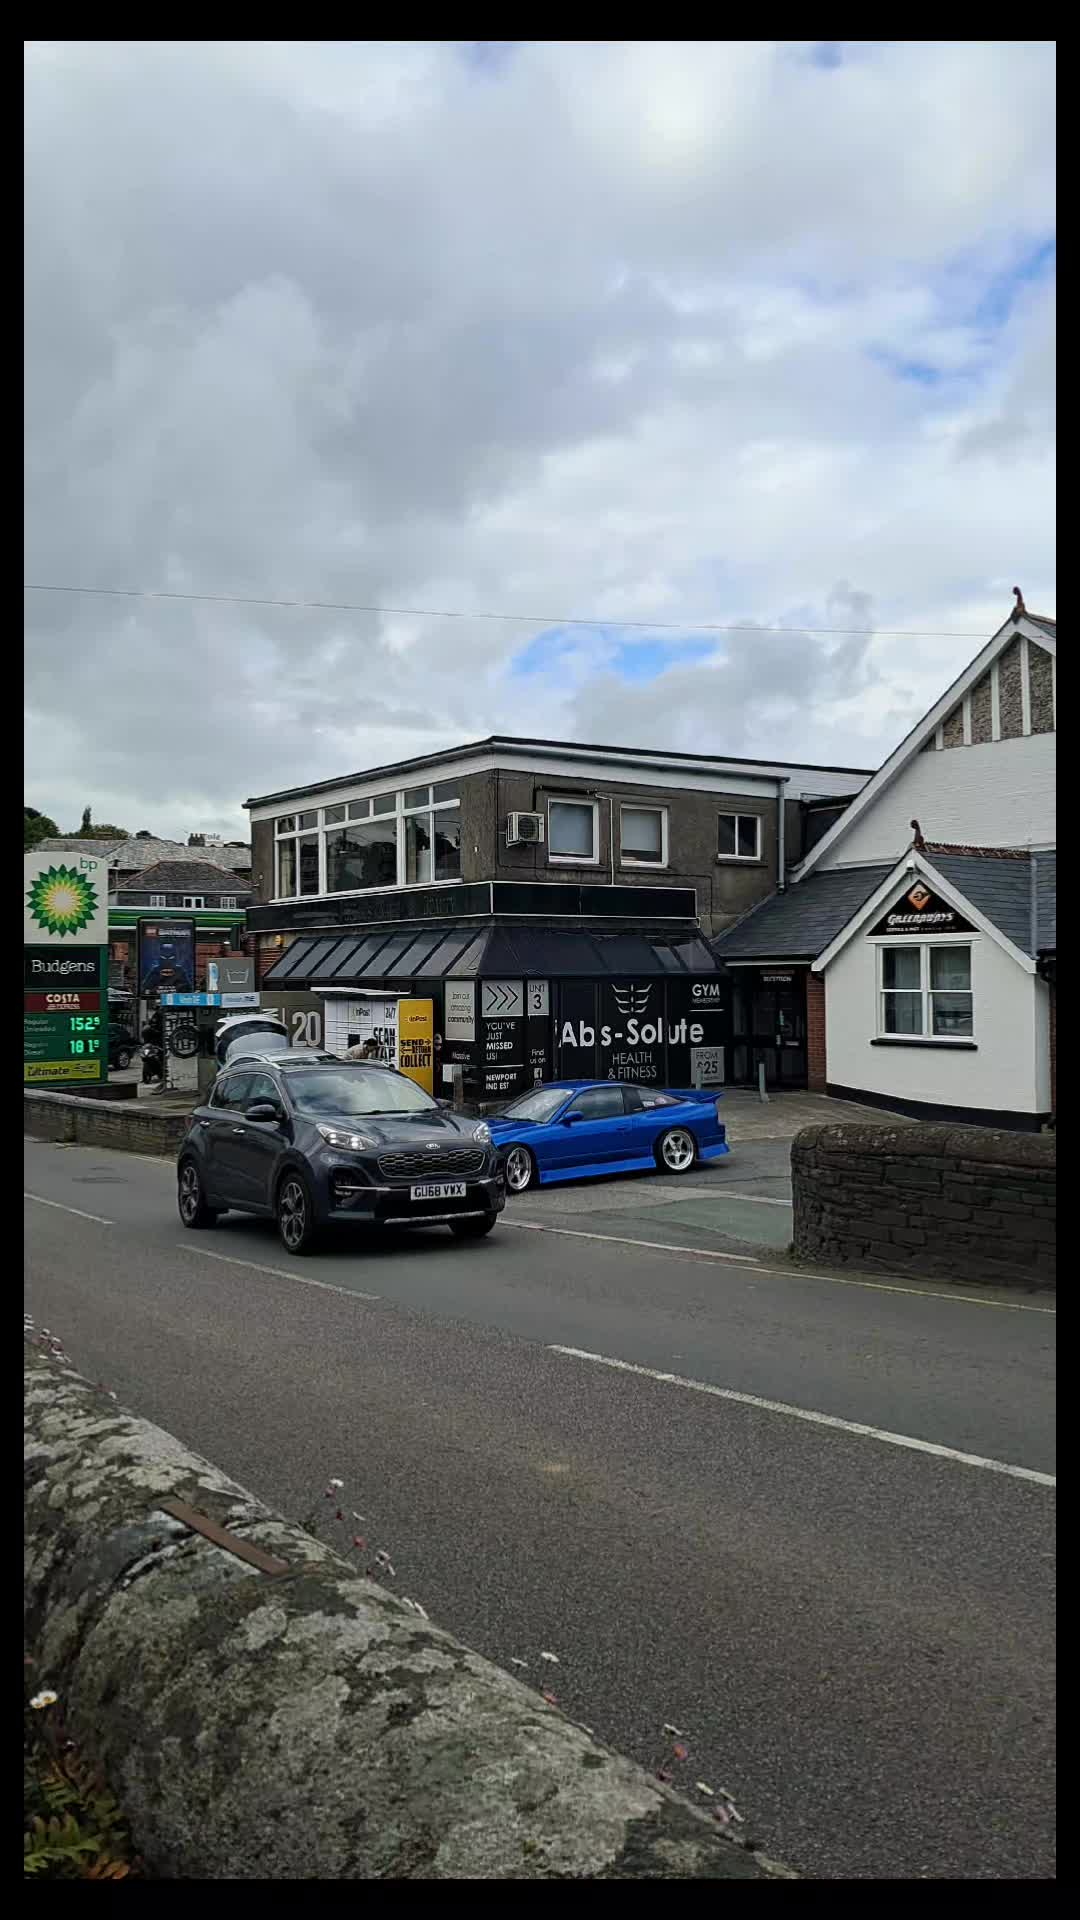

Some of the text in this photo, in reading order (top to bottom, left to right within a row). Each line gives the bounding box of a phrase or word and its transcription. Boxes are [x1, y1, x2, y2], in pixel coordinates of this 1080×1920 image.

[80, 858, 98, 872] bp
[31, 959, 96, 975] Budgens
[529, 984, 545, 992] UNIT
[692, 983, 720, 997] GYM
[46, 993, 80, 1004] COSTA
[533, 994, 542, 1010] 3
[291, 1010, 321, 1048] 20
[487, 1032, 503, 1040] JUST
[373, 1027, 396, 1047] SCAN
[400, 1038, 425, 1046] SEND
[486, 1042, 514, 1050] MISSED
[400, 1054, 432, 1067] COLLECT
[612, 1051, 652, 1065] HEALTH
[696, 1051, 718, 1060] FROM
[486, 1072, 517, 1081] NEWPORT
[608, 1066, 657, 1080] & FITNESS
[414, 1183, 463, 1198] GU68 VWX
